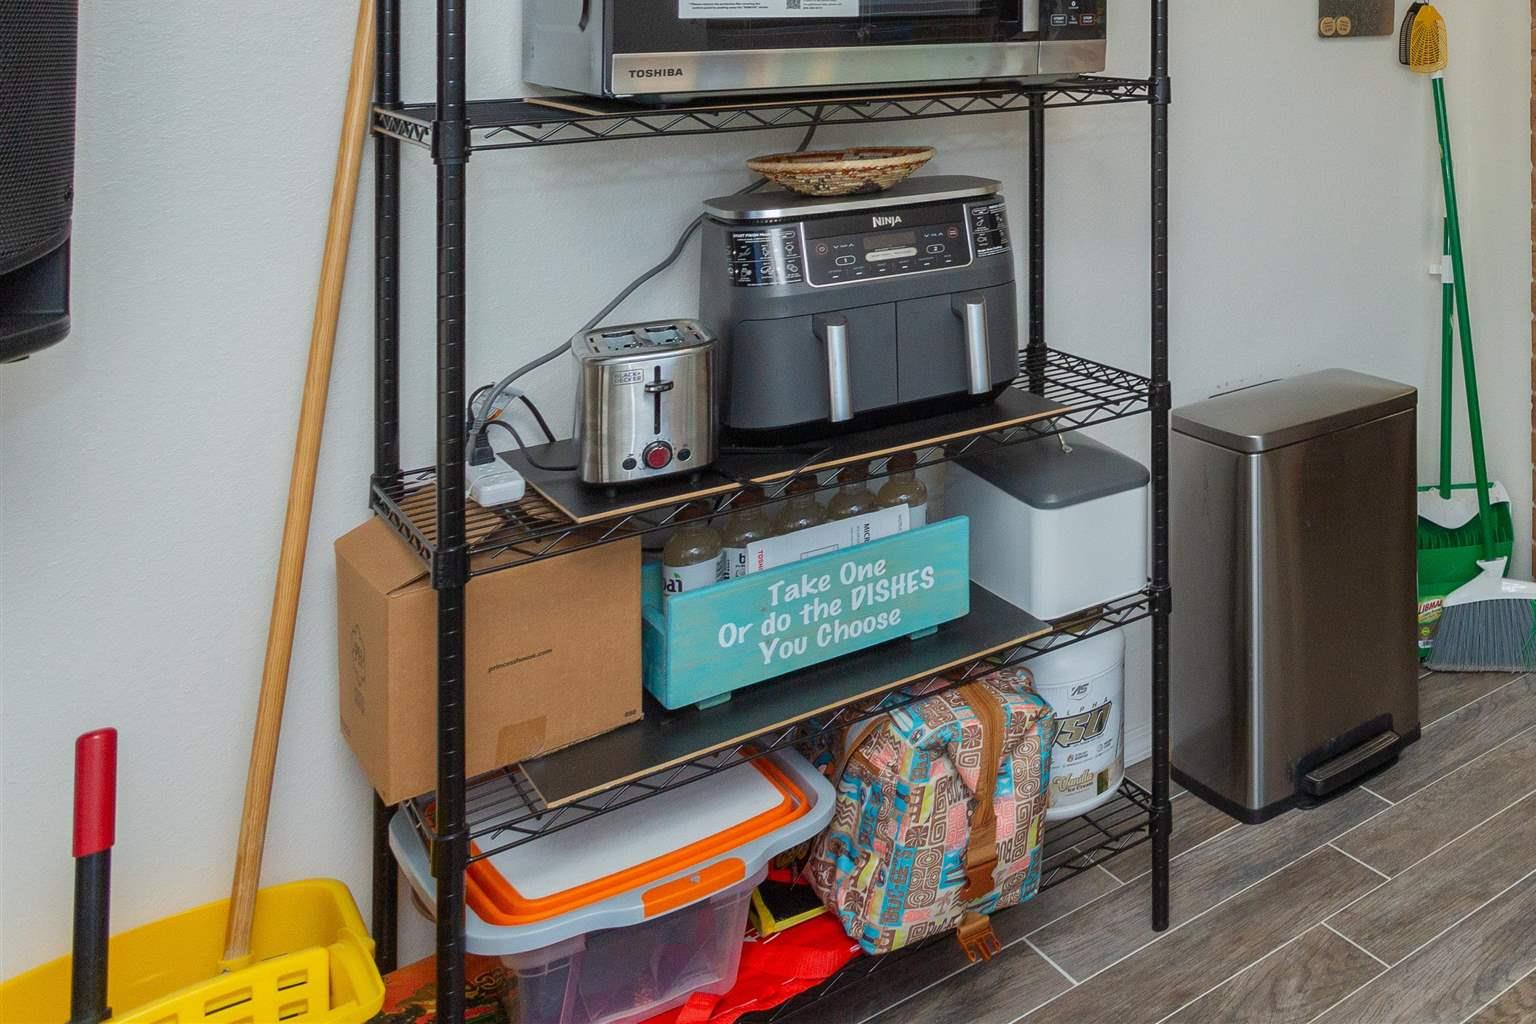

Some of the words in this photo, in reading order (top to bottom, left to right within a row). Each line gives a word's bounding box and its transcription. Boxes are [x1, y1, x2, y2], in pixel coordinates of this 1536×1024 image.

[628, 68, 683, 78] TOSHIBA
[872, 215, 902, 228] NINJA
[767, 572, 832, 607] Take
[839, 558, 887, 586] One
[717, 622, 754, 649] Or
[760, 609, 791, 638] do
[799, 597, 843, 626] the
[850, 565, 935, 609] DISHES
[758, 634, 807, 666] You
[816, 607, 902, 649] Choose
[1052, 768, 1096, 792] Vanilla
[1076, 781, 1094, 791] Cream
